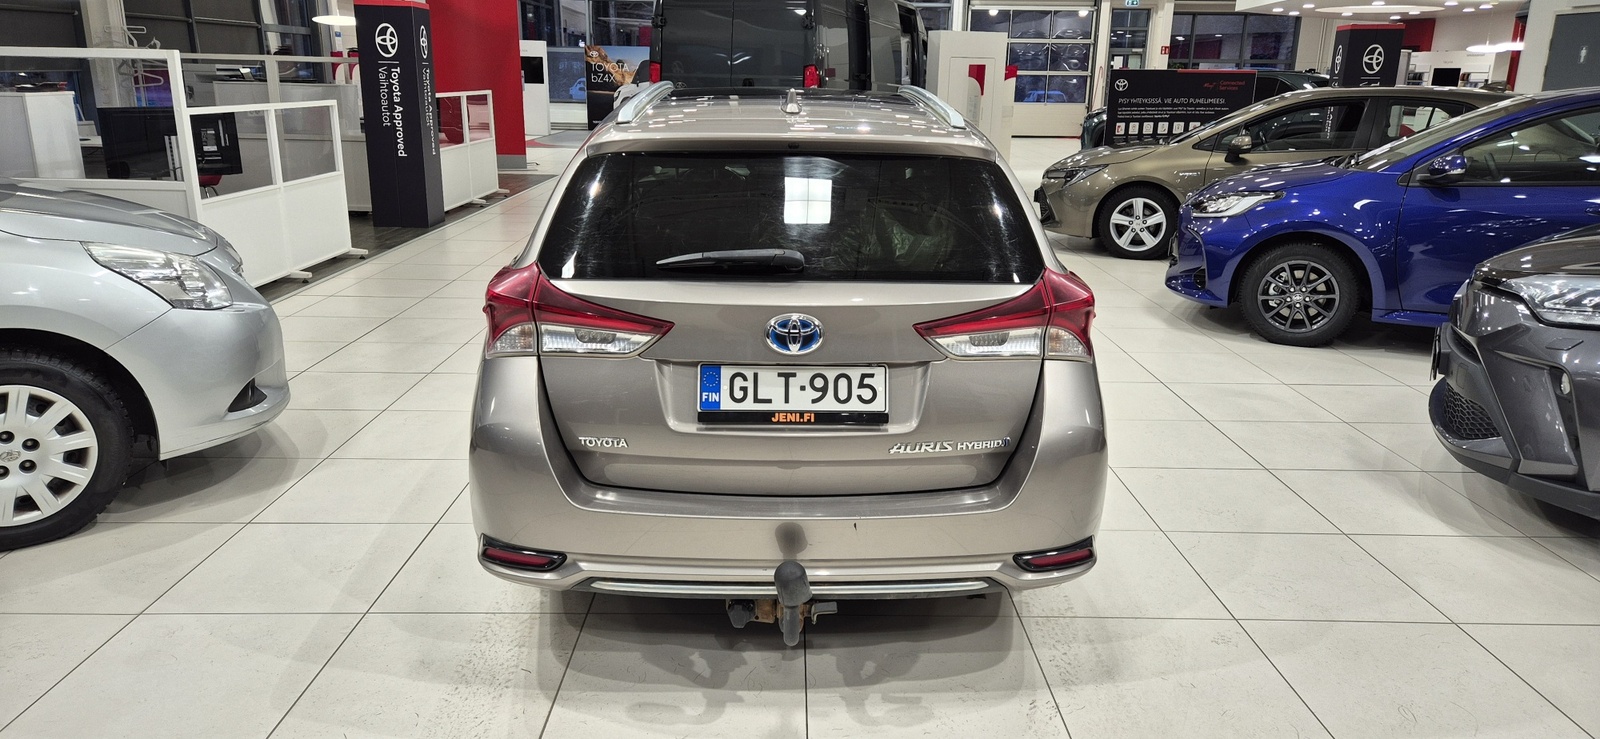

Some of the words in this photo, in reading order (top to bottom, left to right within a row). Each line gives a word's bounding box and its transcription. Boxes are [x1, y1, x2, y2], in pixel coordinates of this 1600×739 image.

[591, 62, 630, 72] TOYOTA
[390, 66, 401, 103] Toyota
[591, 73, 616, 83] bZ4X
[378, 66, 391, 127] Vaihtoautot
[393, 104, 408, 157] Approved
[428, 104, 437, 156] Approved
[702, 392, 720, 402] FIN
[771, 412, 815, 422] JENI.FI
[578, 436, 628, 448] TOYOTA
[889, 441, 954, 454] AURIS
[957, 439, 1002, 451] HYBRID
